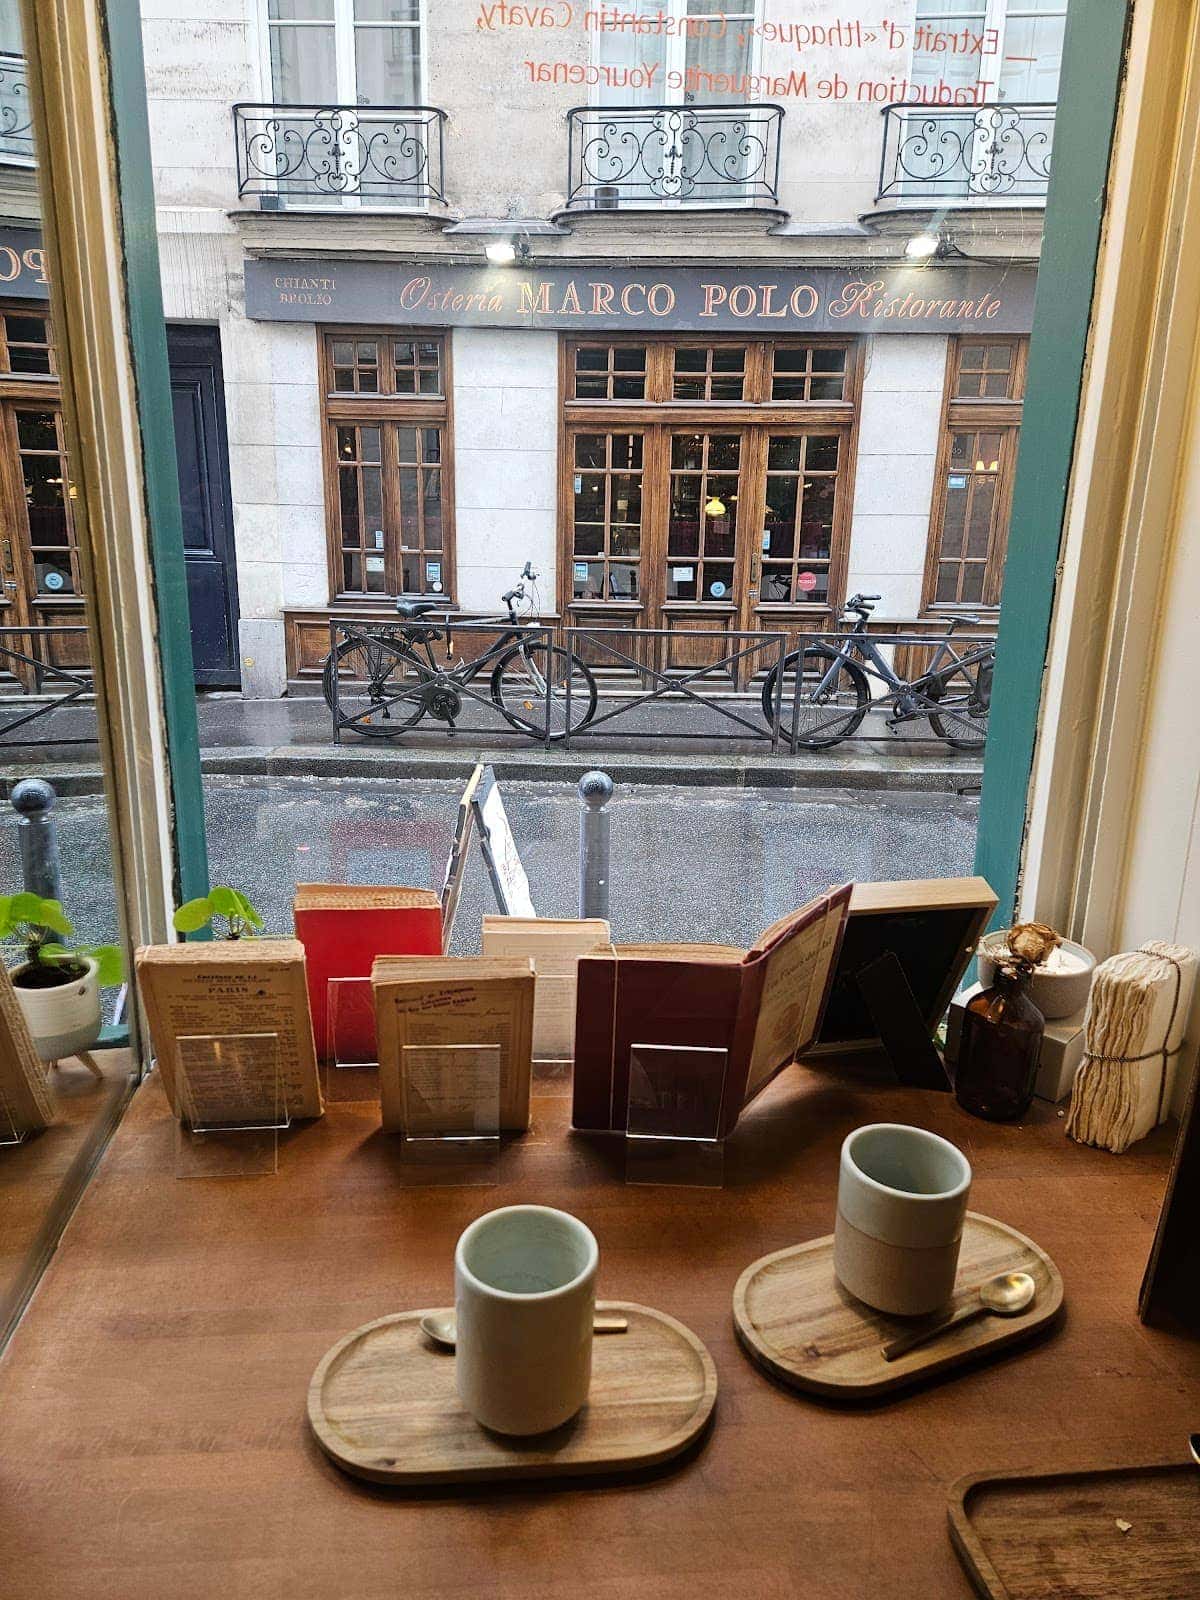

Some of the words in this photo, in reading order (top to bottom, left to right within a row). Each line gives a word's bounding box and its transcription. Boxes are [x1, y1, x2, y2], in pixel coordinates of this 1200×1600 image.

[274, 277, 337, 290] CHIANTI
[400, 276, 504, 311] Osteria
[517, 281, 676, 316] MARCO
[700, 283, 820, 318] POLO
[828, 280, 1002, 320] Ristorante
